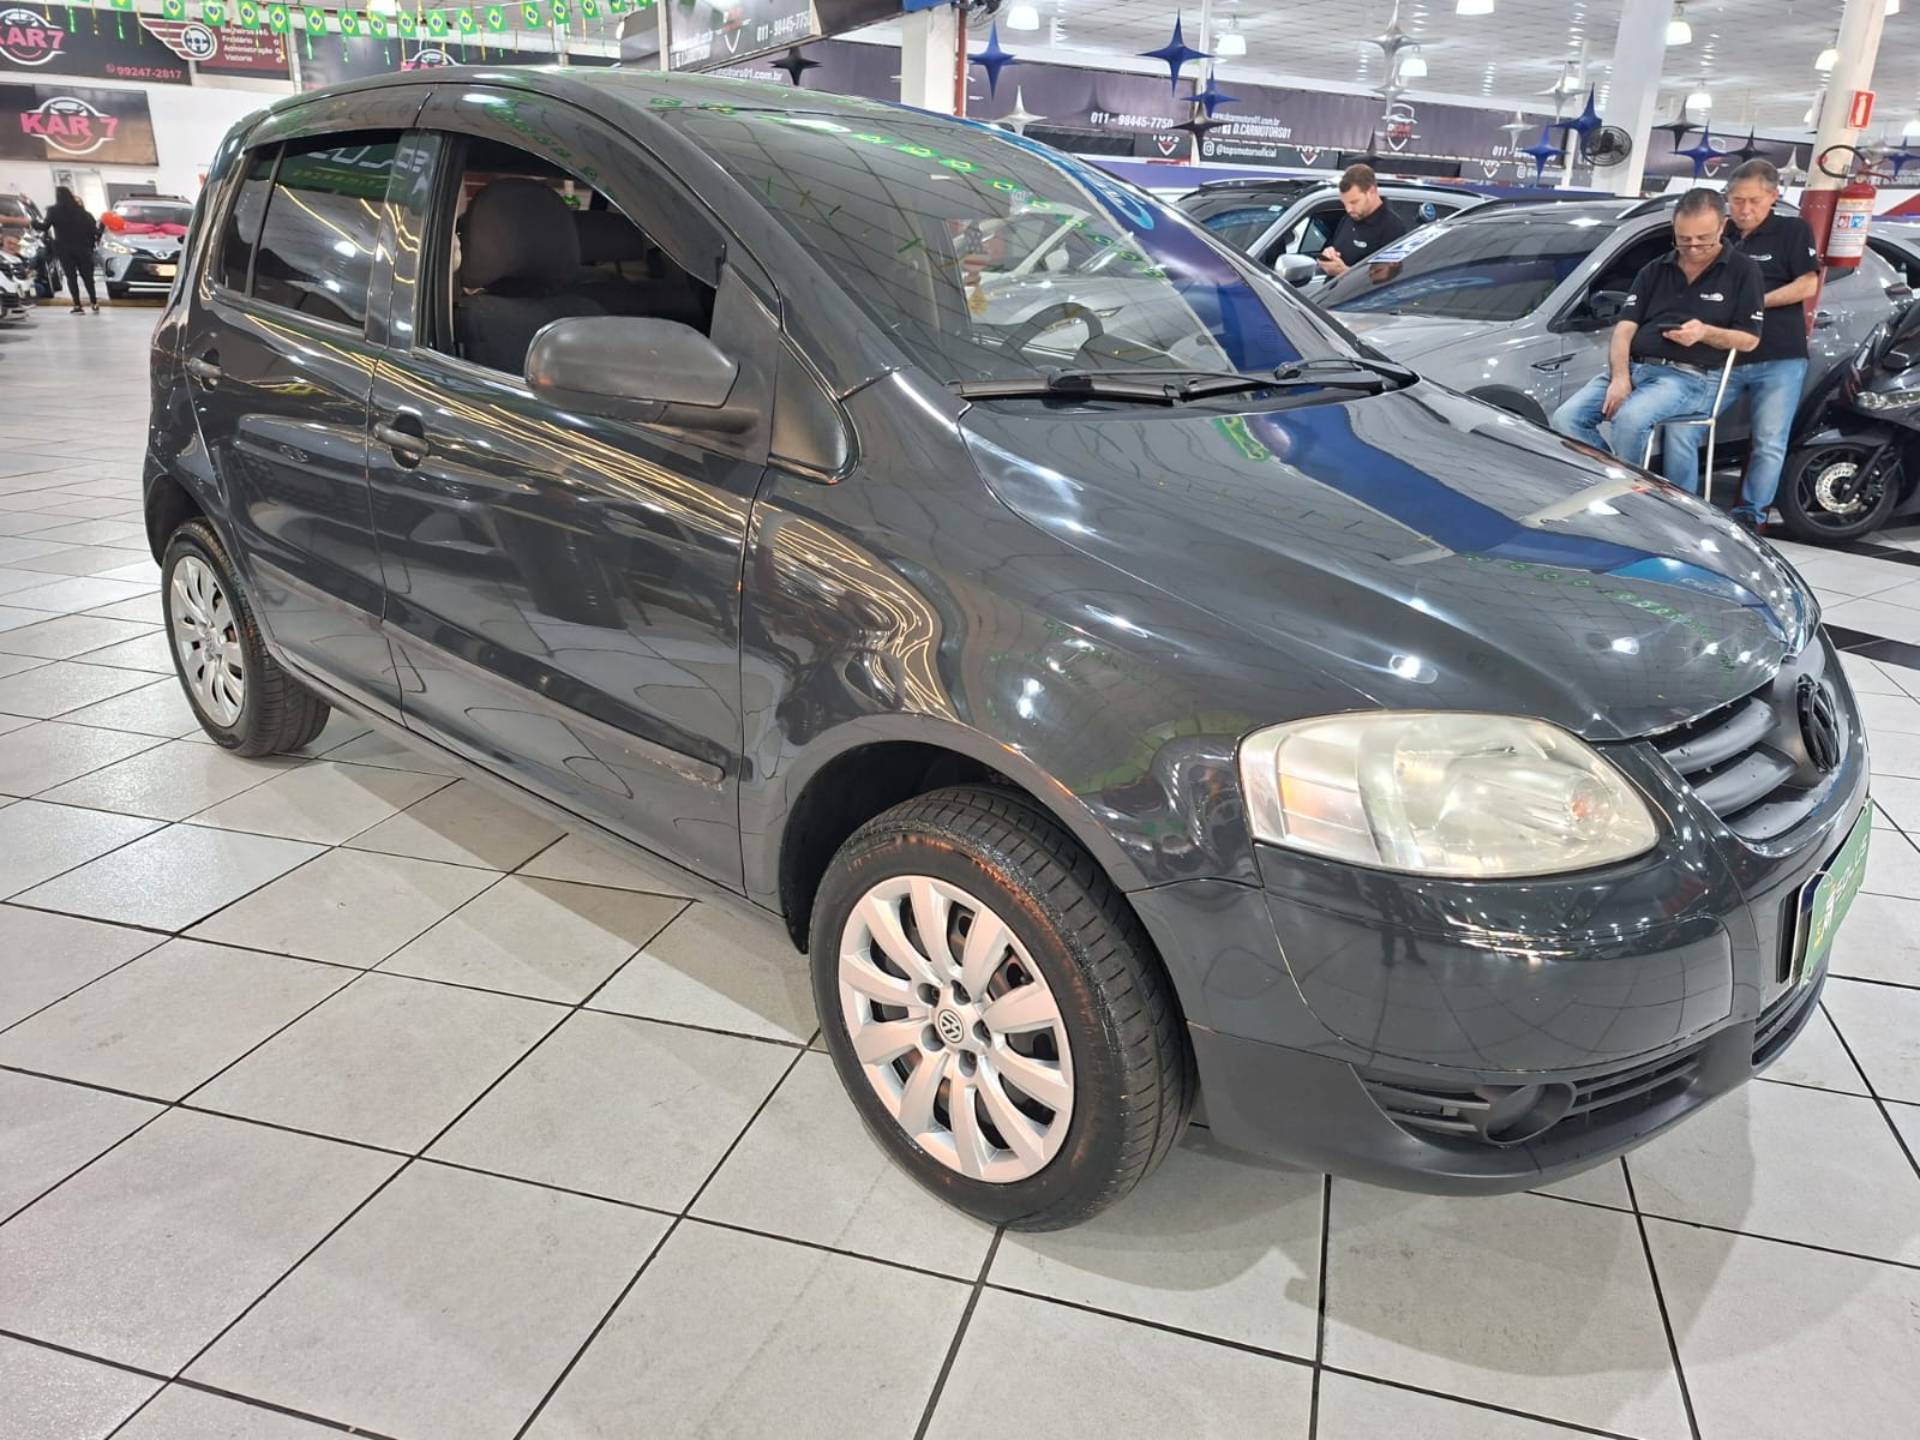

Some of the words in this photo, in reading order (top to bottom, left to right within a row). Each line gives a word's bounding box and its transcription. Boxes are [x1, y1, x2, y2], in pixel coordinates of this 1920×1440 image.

[20, 113, 93, 137] KAR
[100, 117, 119, 138] 7
[1090, 111, 1110, 124] 011
